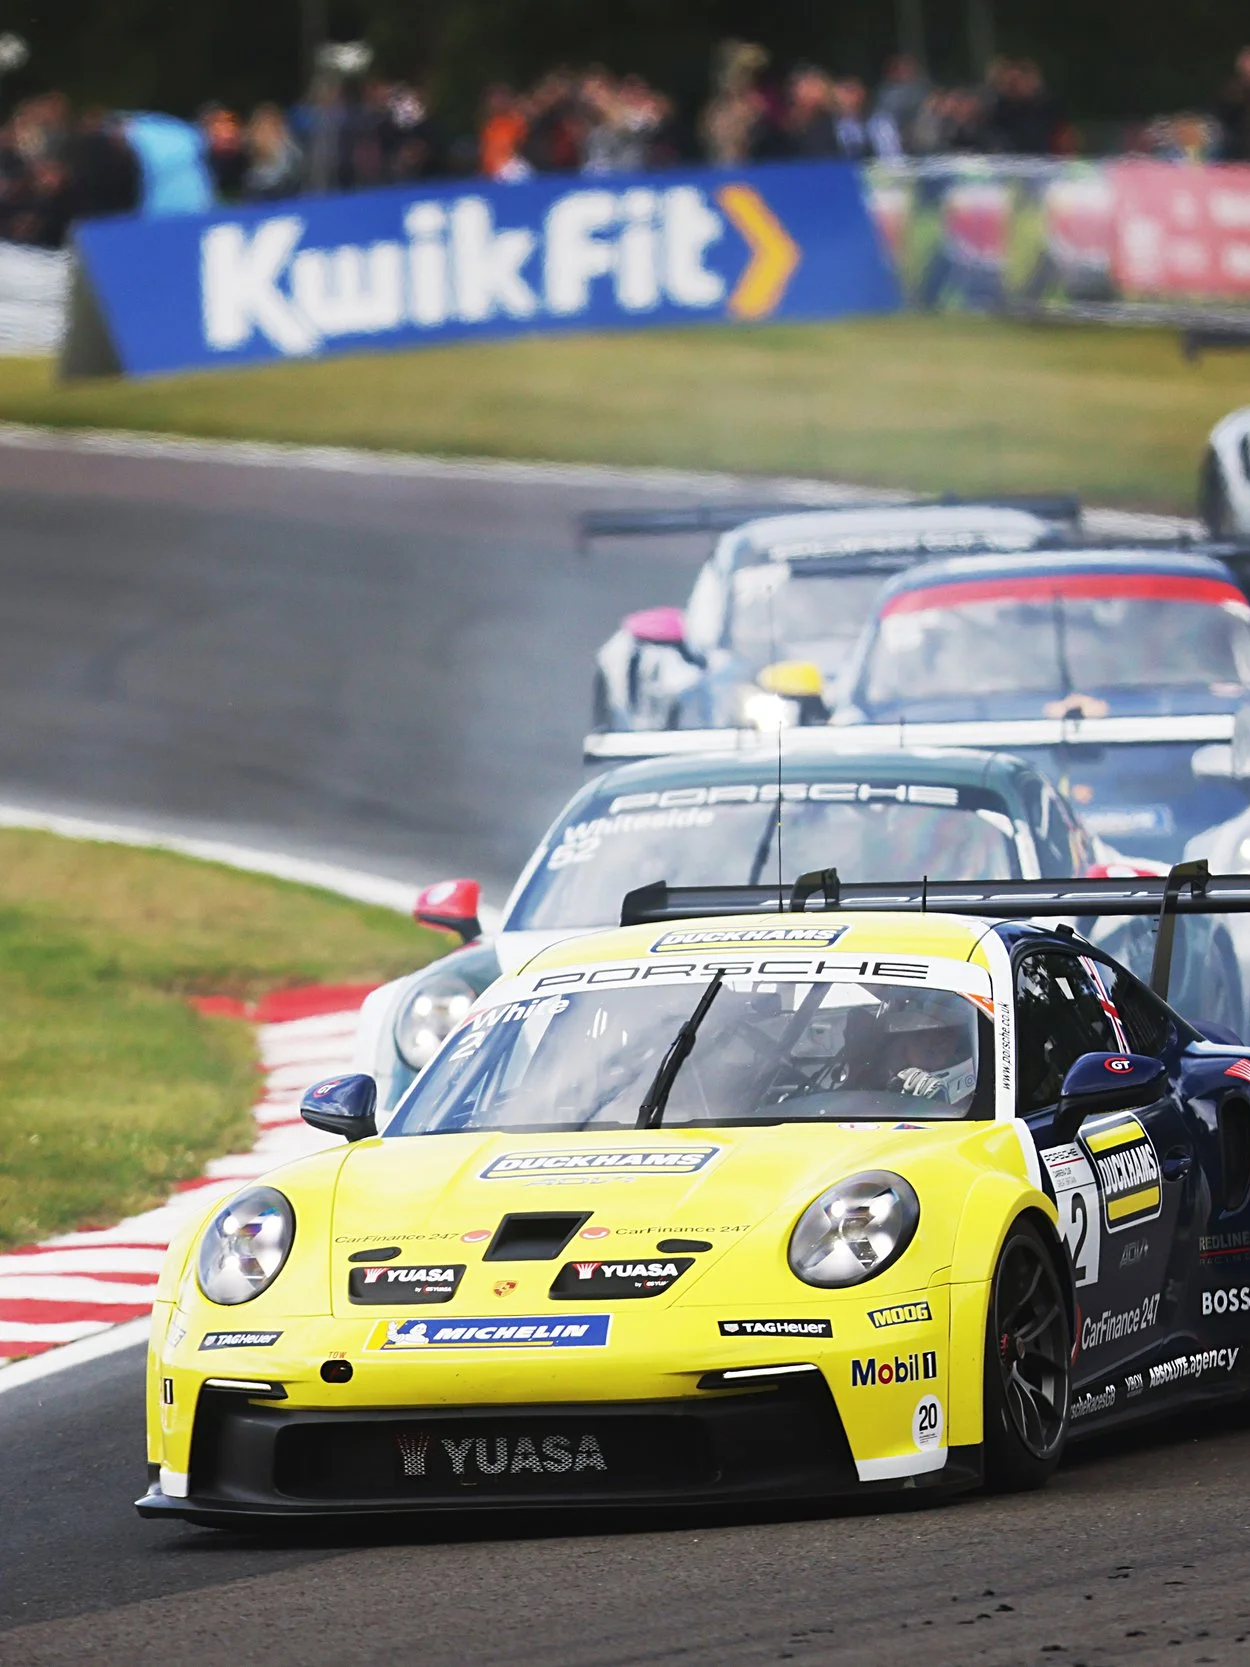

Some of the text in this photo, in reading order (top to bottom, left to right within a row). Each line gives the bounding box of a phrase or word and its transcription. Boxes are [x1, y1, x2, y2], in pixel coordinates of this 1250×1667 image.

[609, 783, 959, 814] PORSCHE
[564, 809, 716, 843] Whiteside
[665, 927, 840, 946] DUCKHAMS
[531, 960, 930, 993] PORSCHE
[449, 1031, 485, 1062] 2
[1111, 1060, 1130, 1070] GT
[493, 1153, 705, 1171] DUCKHAMS
[1097, 1143, 1157, 1195] DUCKHAMS
[335, 1233, 459, 1244] CarFinance 247
[615, 1225, 750, 1235] CarFinance 247
[1071, 1192, 1088, 1282] 2
[1199, 1231, 1250, 1251] REDLINE
[387, 1269, 455, 1282] YUASA
[601, 1263, 679, 1278] YUASA
[874, 1301, 929, 1327] MOOG
[1082, 1293, 1160, 1351] CarFinance 247
[433, 1324, 590, 1340] MICHELIN
[328, 1351, 347, 1359] TOW
[1149, 1347, 1240, 1389] ABSOLUTE.agency
[852, 1352, 936, 1387] Mobil 1
[919, 1403, 937, 1431] 20
[441, 1434, 608, 1475] YUASA
